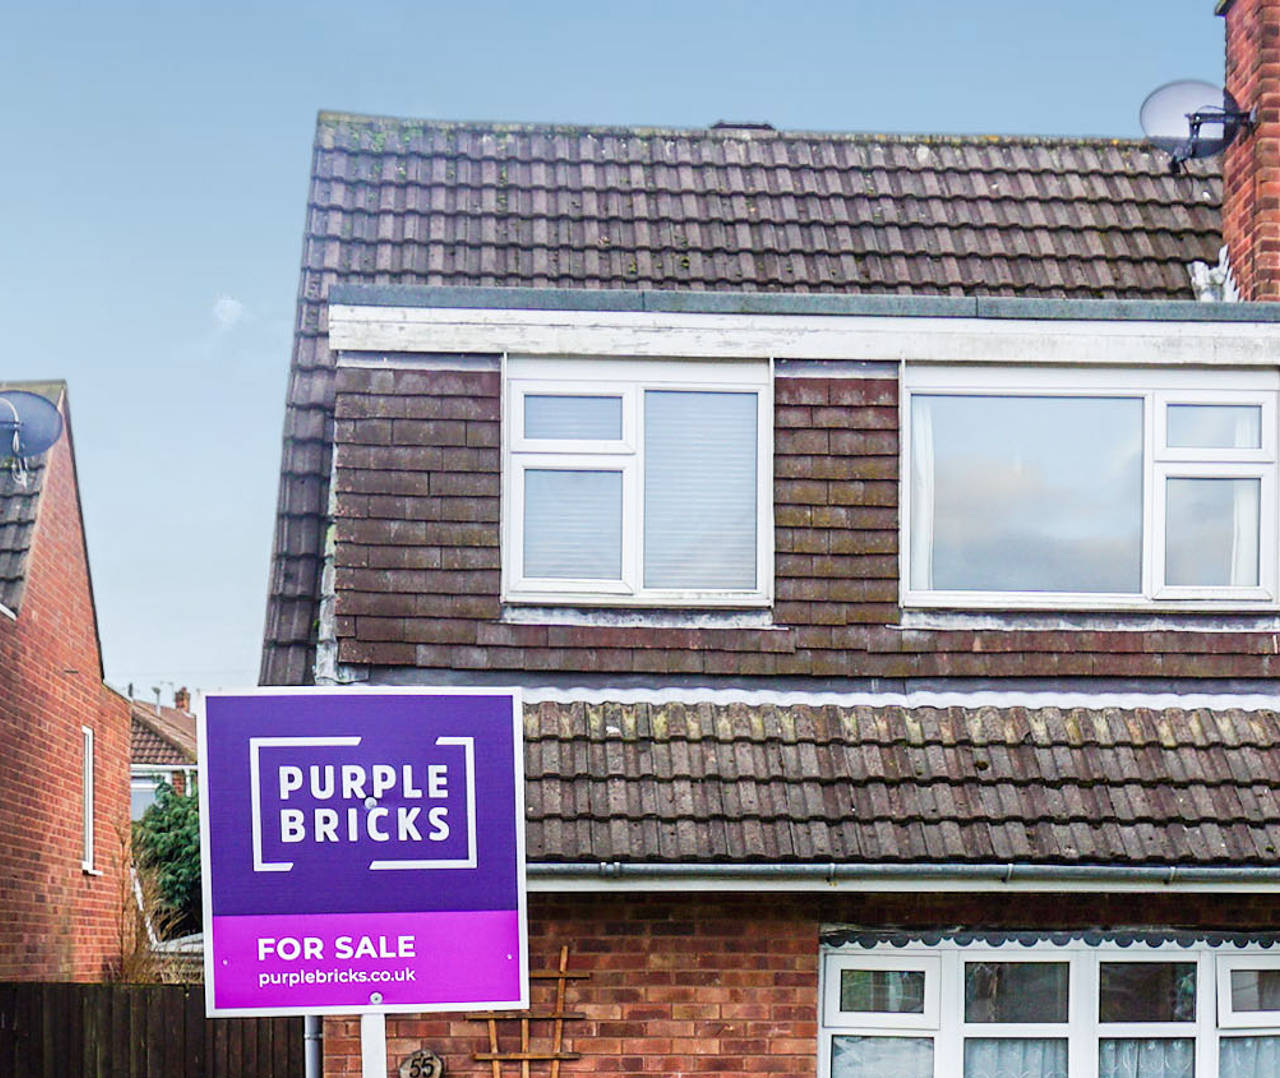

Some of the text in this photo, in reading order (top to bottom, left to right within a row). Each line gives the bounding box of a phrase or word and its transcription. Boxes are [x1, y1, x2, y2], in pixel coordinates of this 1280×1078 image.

[279, 765, 448, 799] PURPLE
[280, 807, 450, 842] BRICKS
[258, 936, 416, 961] FOR SALE
[259, 967, 416, 987] purplebricks.co.uk
[410, 1057, 434, 1078] 55
